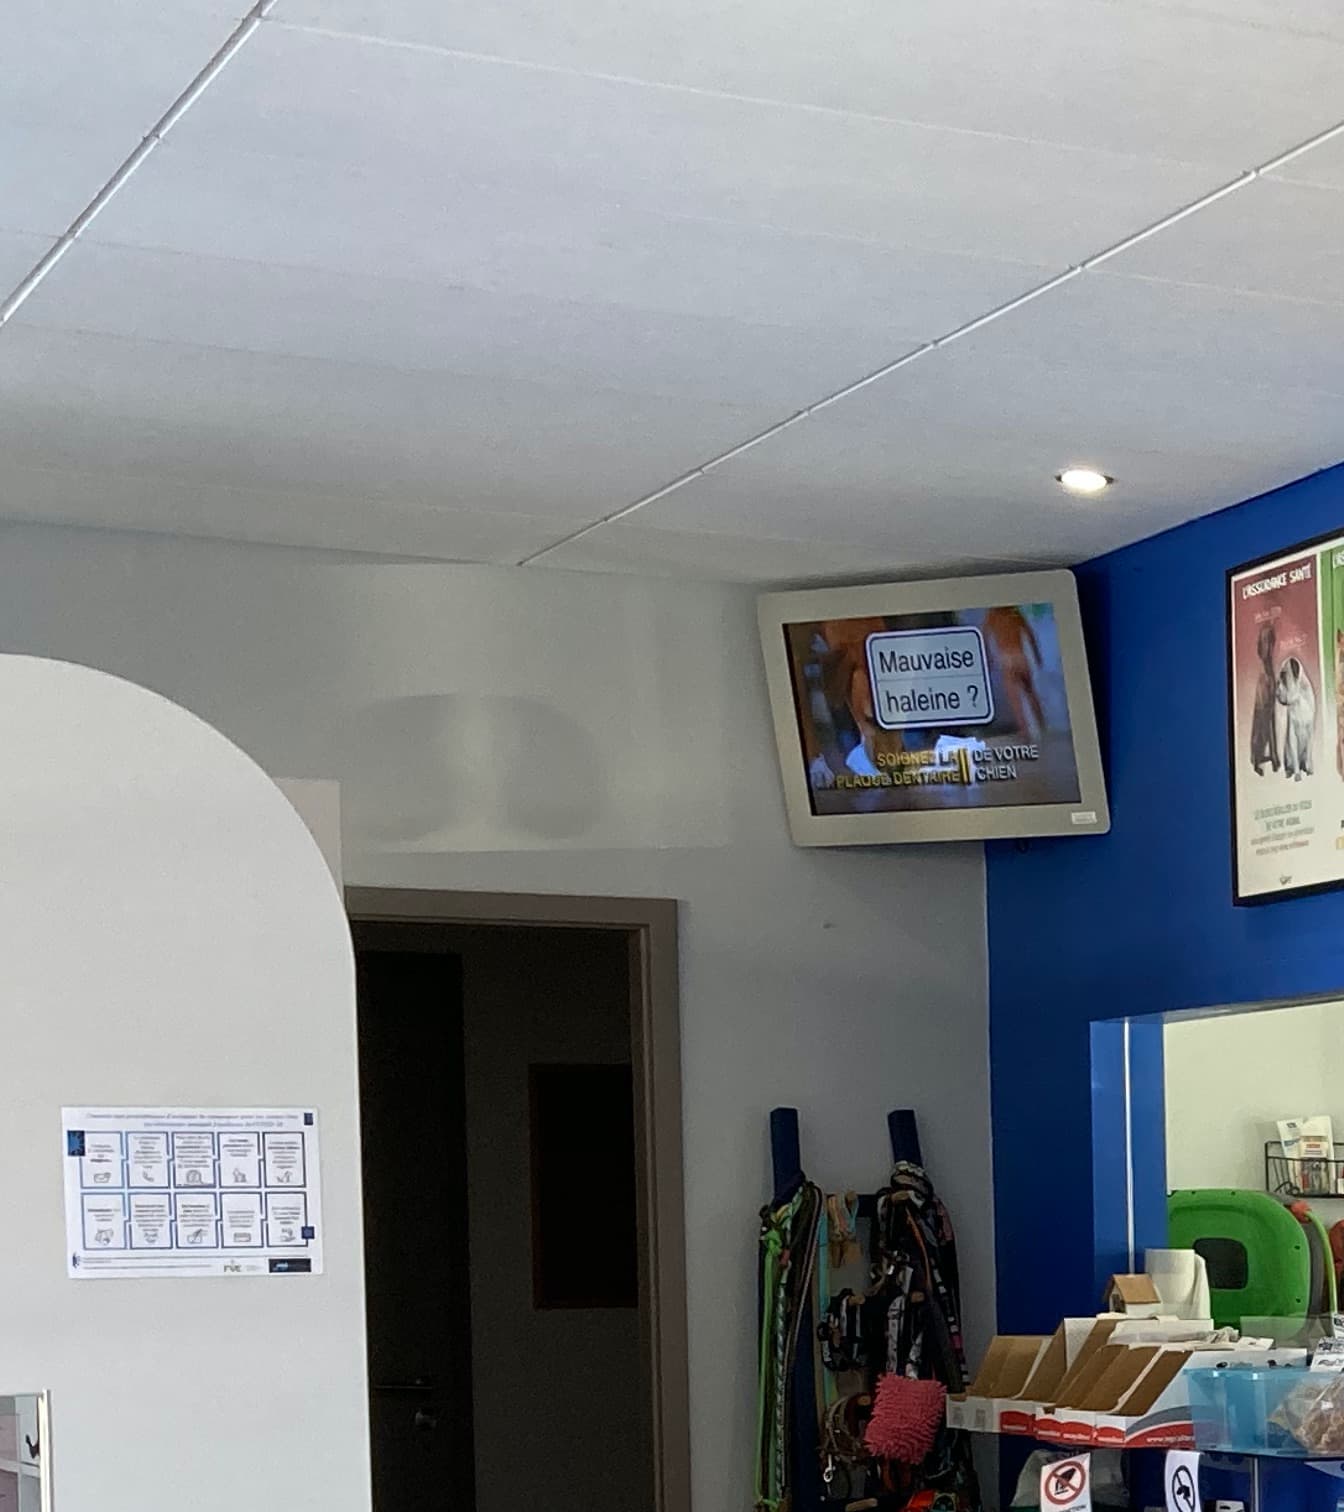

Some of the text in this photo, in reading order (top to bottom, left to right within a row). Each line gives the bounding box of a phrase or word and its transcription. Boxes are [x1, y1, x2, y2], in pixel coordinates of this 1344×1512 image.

[879, 646, 975, 674] Mauvaise
[886, 685, 979, 714] haleine ?
[974, 747, 993, 762] DE
[995, 745, 1039, 761] VOTRE
[977, 766, 1017, 780] CHIEN
